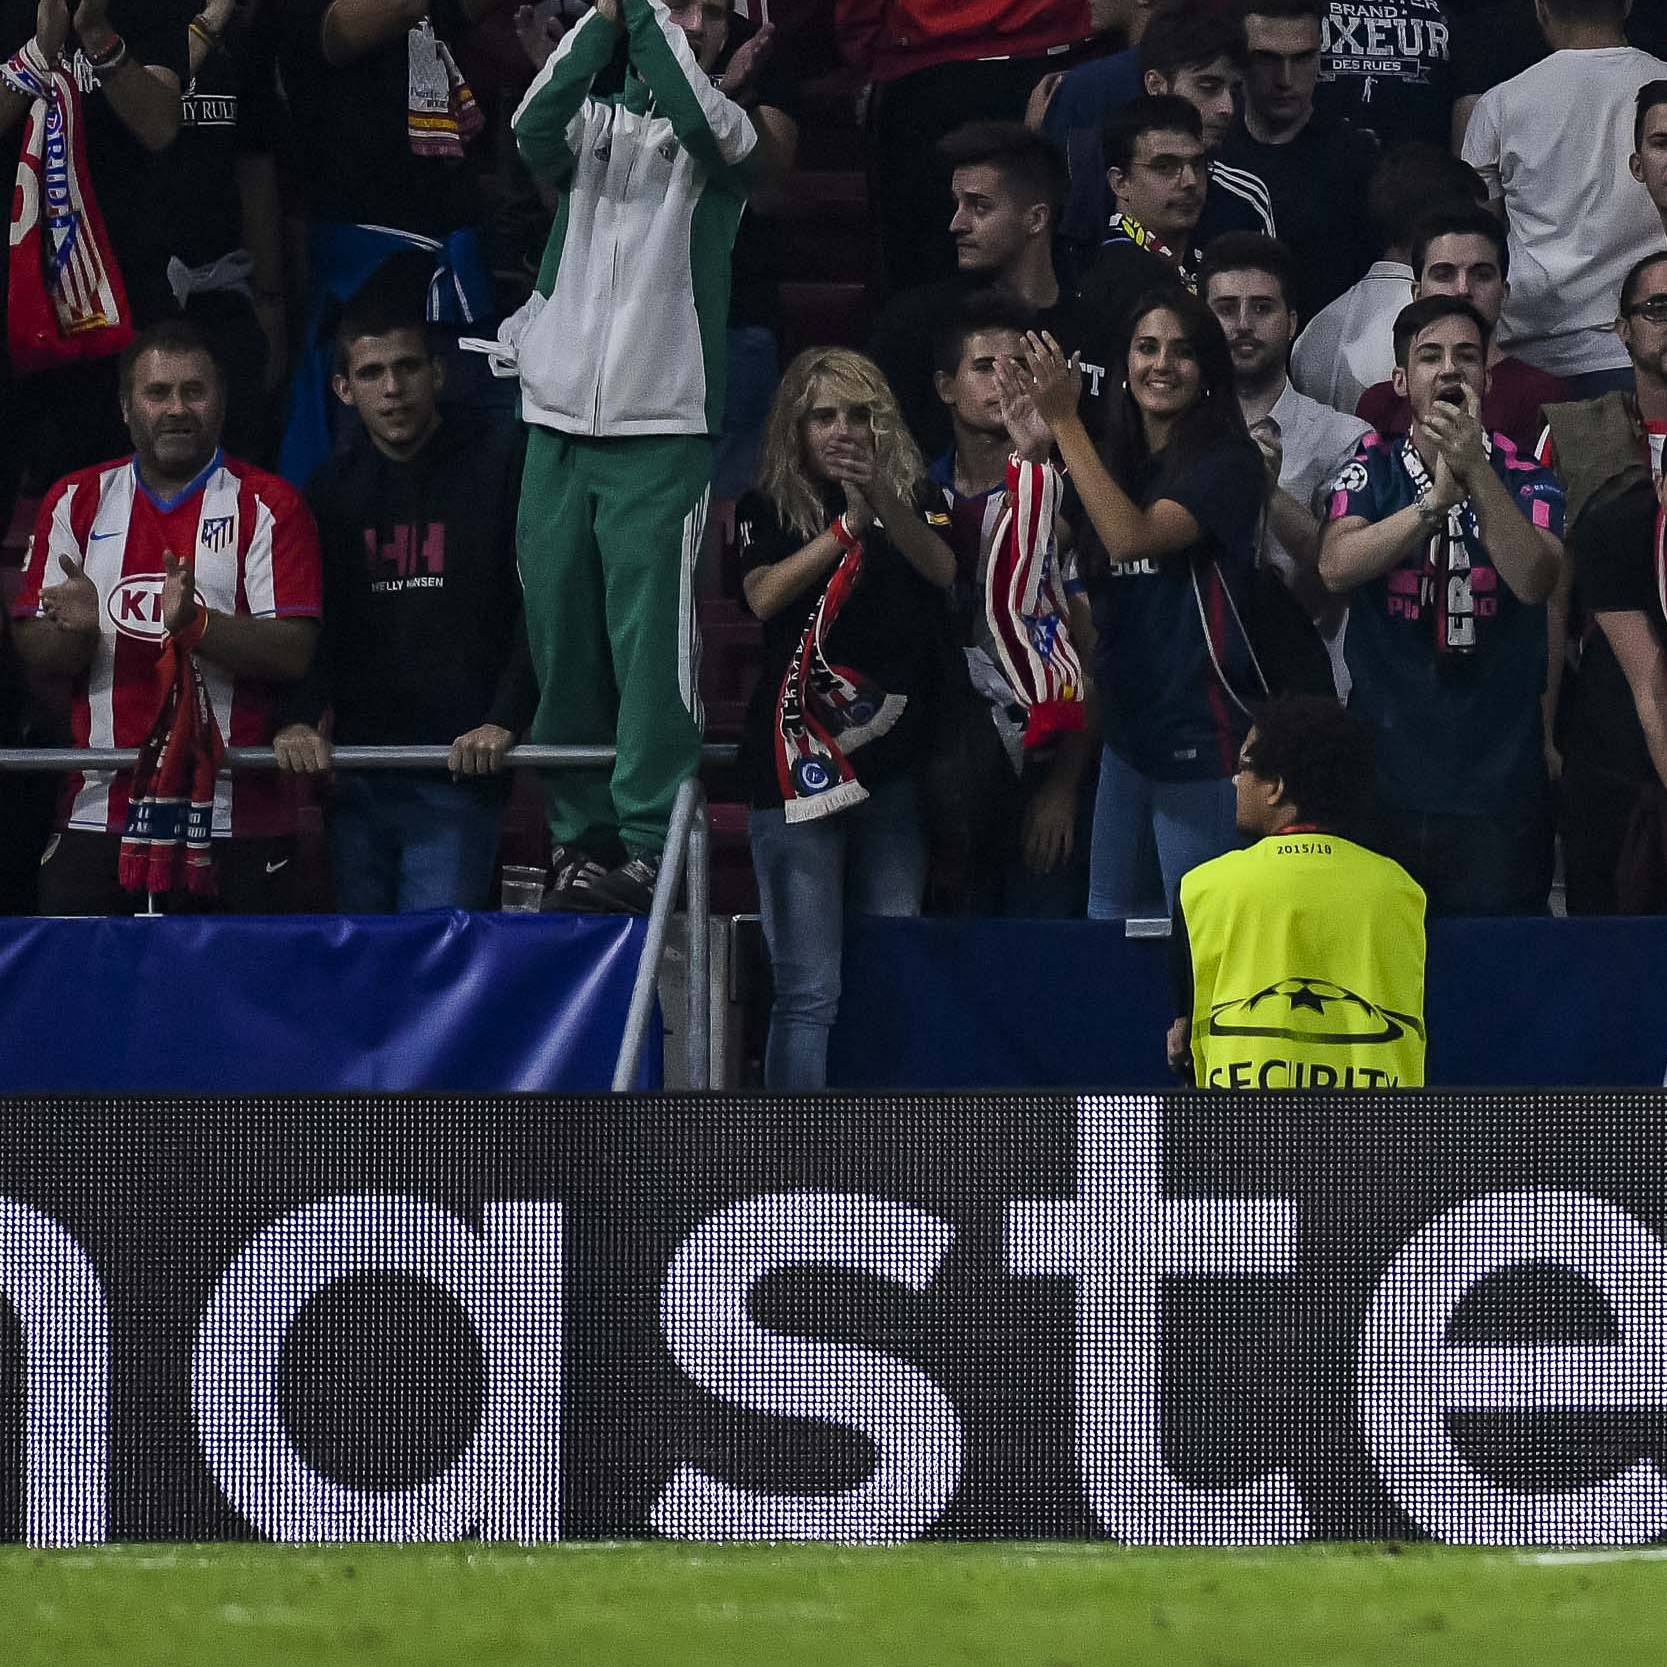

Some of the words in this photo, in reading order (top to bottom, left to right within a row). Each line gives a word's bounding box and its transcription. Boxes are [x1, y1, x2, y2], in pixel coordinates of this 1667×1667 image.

[1329, 2, 1397, 20] BRAND
[1332, 60, 1360, 73] DES
[1363, 60, 1402, 73] RUES
